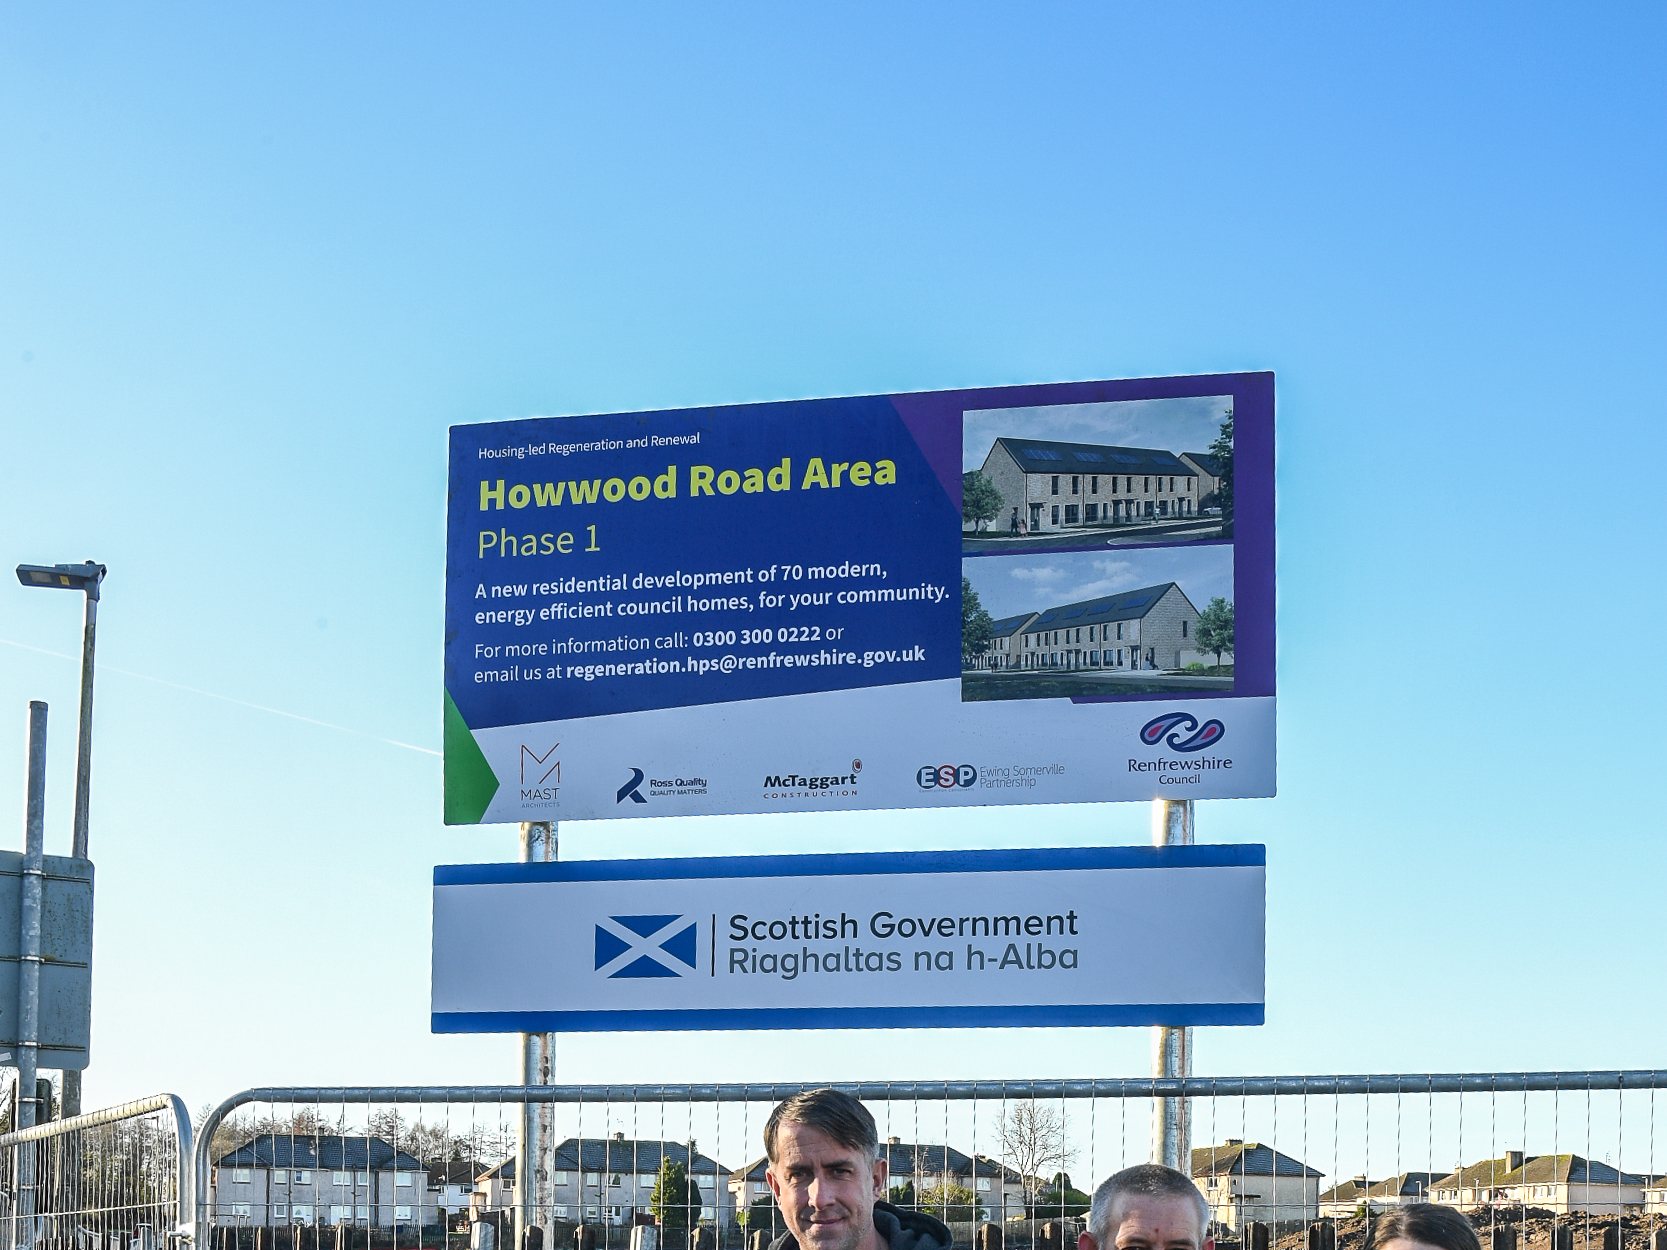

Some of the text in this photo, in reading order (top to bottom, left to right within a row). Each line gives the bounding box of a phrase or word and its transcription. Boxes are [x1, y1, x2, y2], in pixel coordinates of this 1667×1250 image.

[479, 431, 701, 460] Housing-led Regeneration and Renewal
[479, 457, 896, 511] Howwood Road Area
[478, 524, 601, 559] Phase 1
[475, 561, 887, 599] A new residential development of 70 modern,
[475, 582, 950, 627] energy efficient council homes, for your community.
[475, 626, 845, 659] For more information call: 0300 300 0222 or
[474, 645, 926, 684] email us at regeneration.hps@renfrewshire.gov.uk
[980, 763, 1065, 778] Ewing Somerville
[1128, 756, 1233, 772] Renfrewshire
[650, 777, 708, 788] Ross Quality
[764, 773, 857, 790] McTaggart
[921, 767, 974, 787] ESP
[980, 776, 1036, 789] Partnership
[1159, 774, 1201, 785] Council
[521, 787, 560, 801] MAST
[650, 788, 708, 797] QUALITY MATTERS
[763, 790, 858, 799] CONSTRUCTION
[729, 910, 1079, 941] Scottish Government
[729, 942, 1078, 981] Riaghaltas na h-Alba
